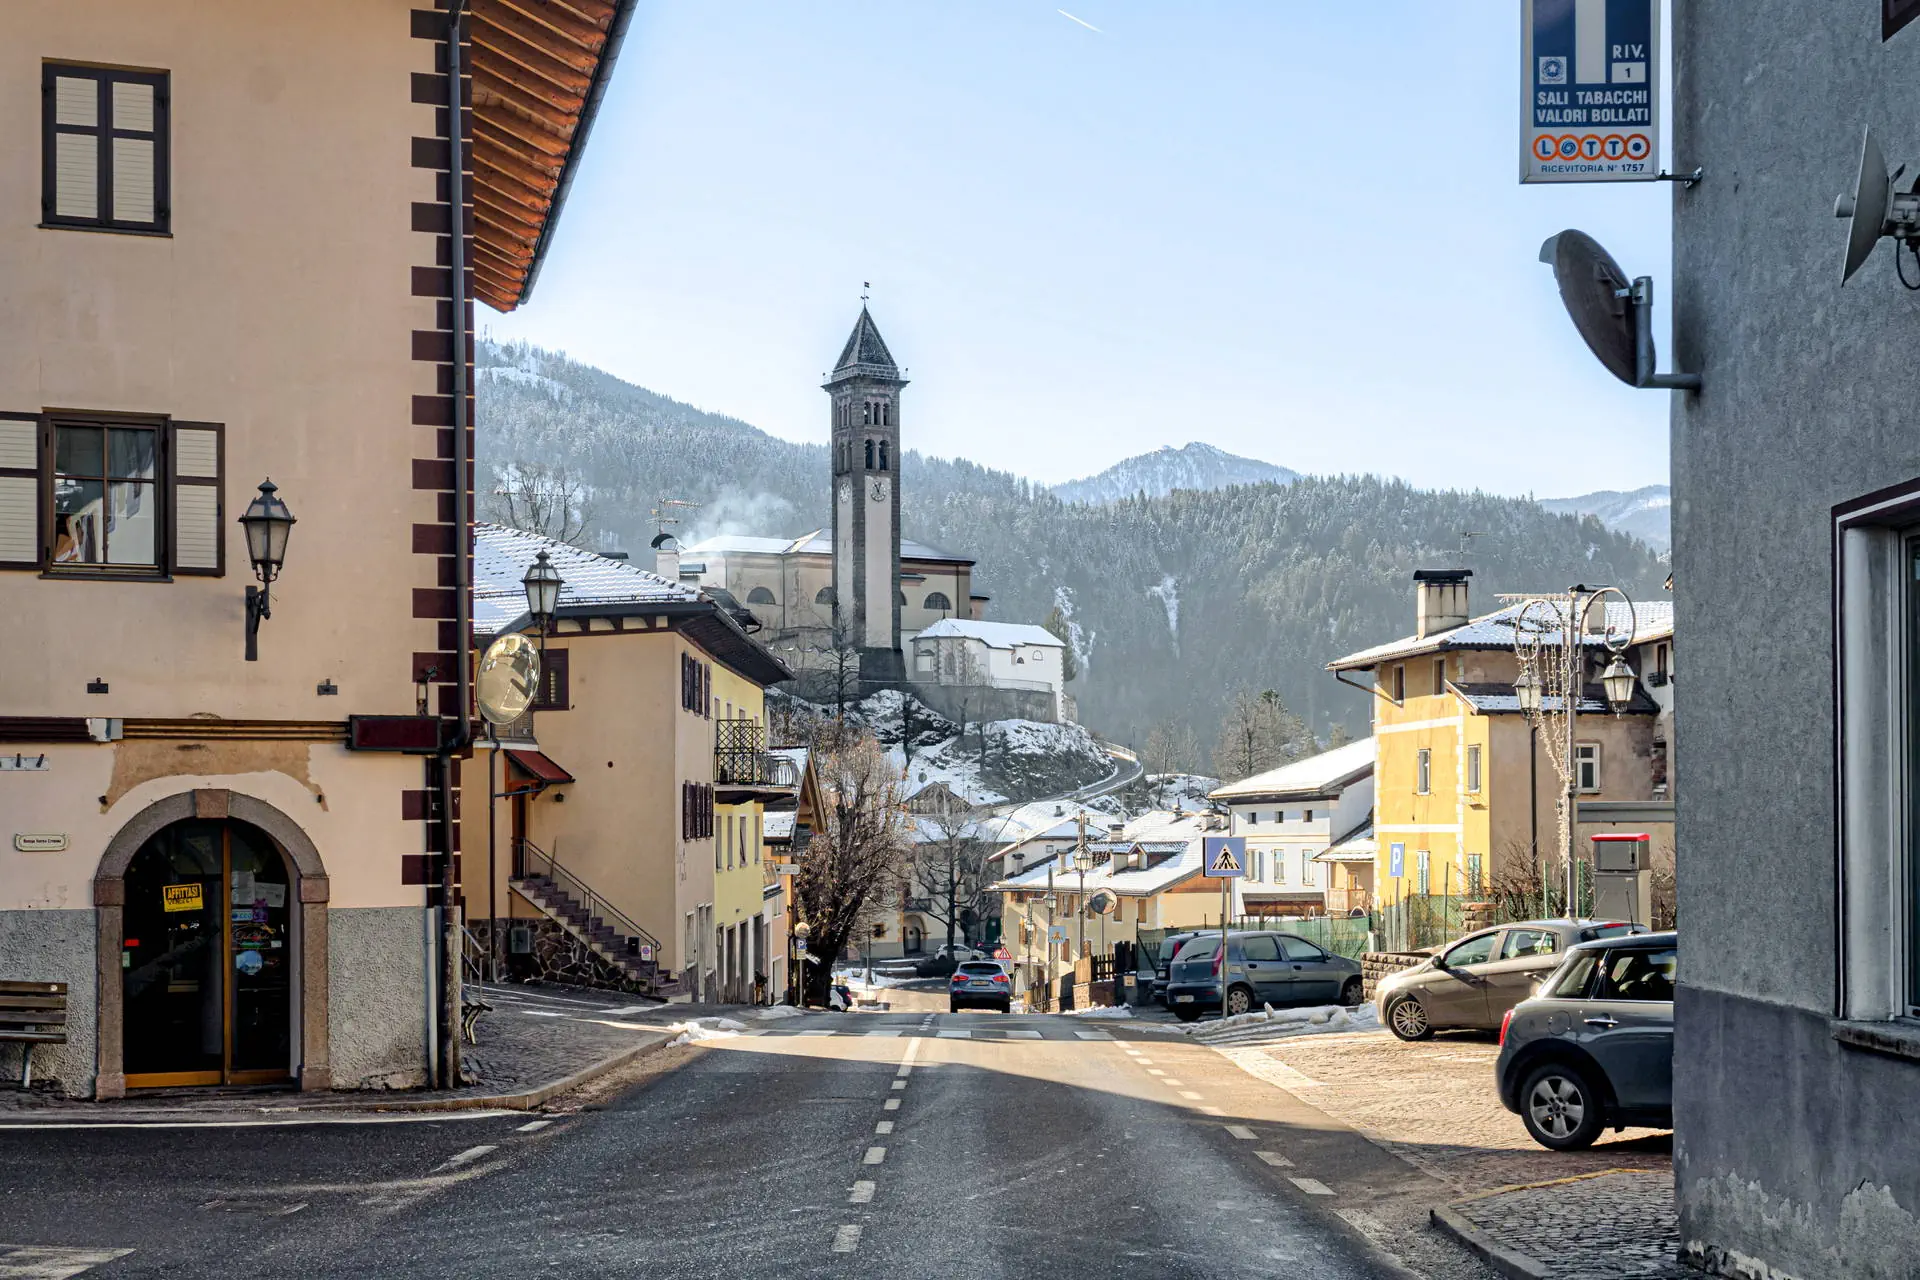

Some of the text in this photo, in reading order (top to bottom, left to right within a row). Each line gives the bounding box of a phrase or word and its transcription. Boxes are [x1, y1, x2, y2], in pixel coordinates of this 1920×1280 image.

[1612, 44, 1645, 59] RIV.
[1625, 67, 1631, 78] 1
[1537, 90, 1648, 105] SALI TABACCHI
[1536, 108, 1649, 123] VALORI BOLLATI
[1533, 134, 1651, 160] LOTTO
[1540, 164, 1604, 173] RICEVITORIA
[1621, 163, 1645, 172] 1757
[1392, 848, 1400, 872] P
